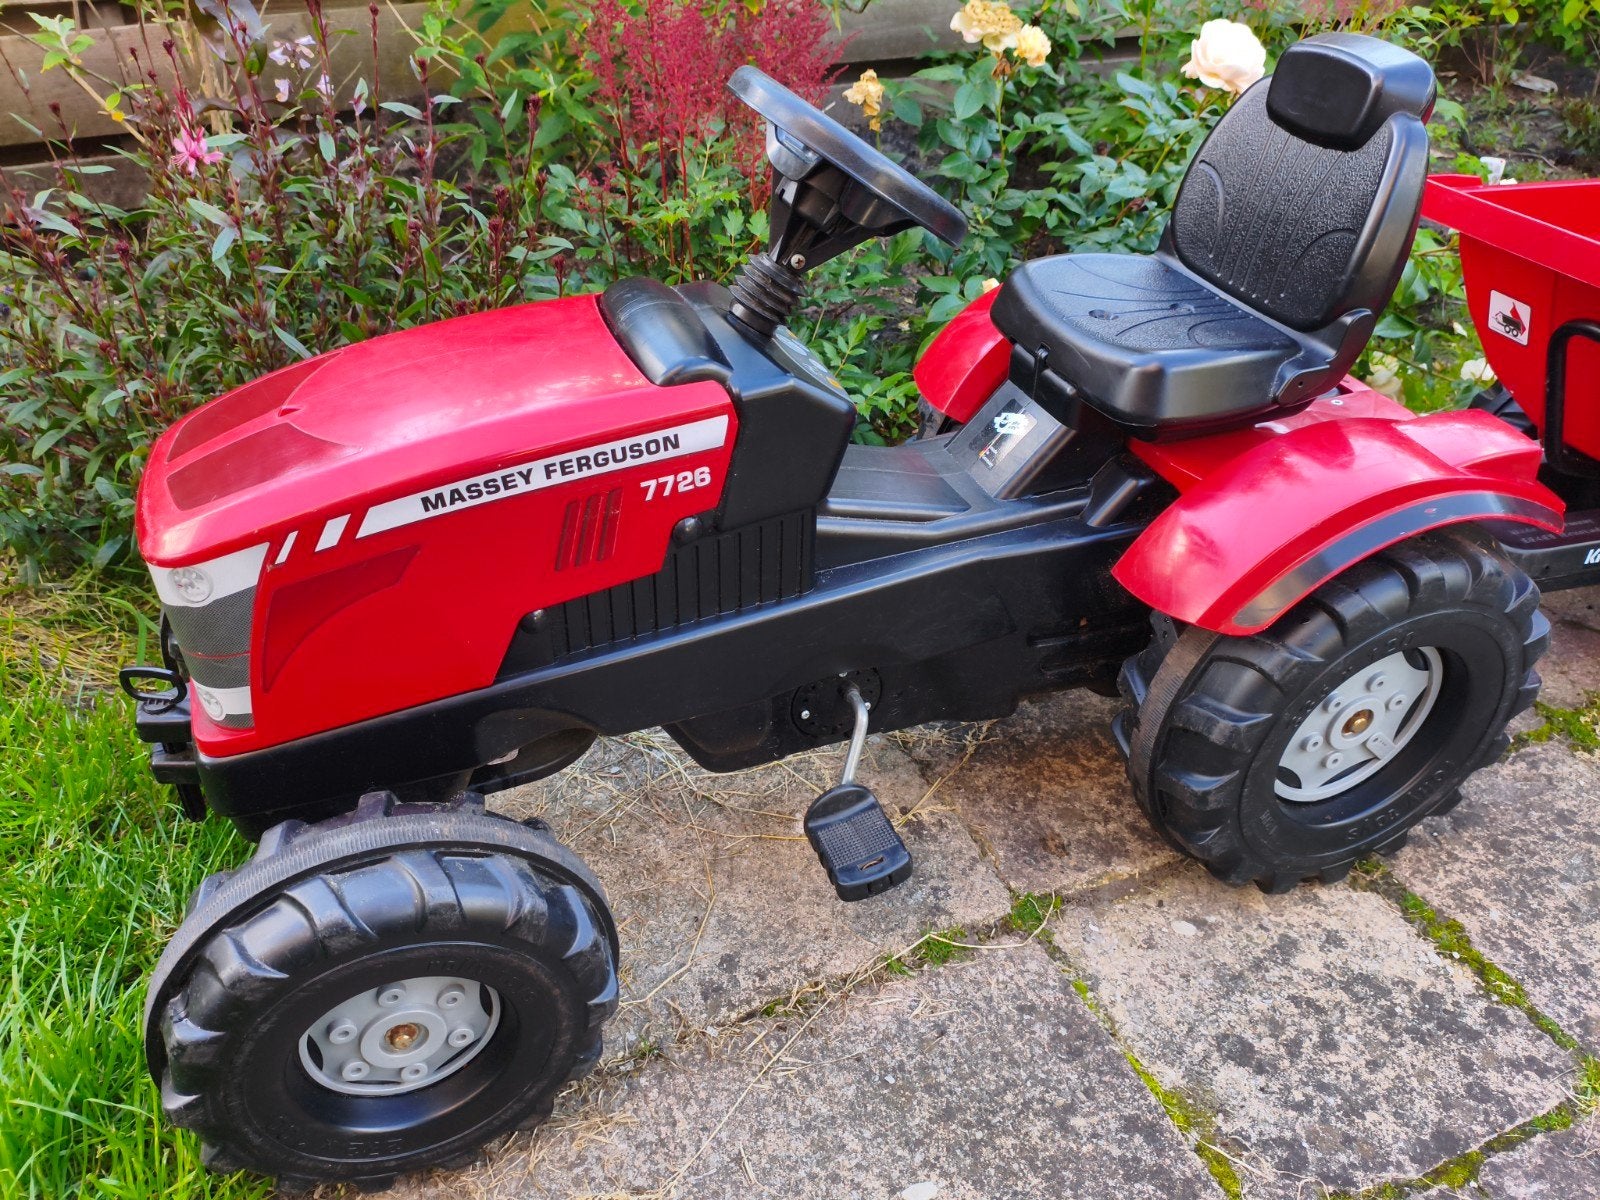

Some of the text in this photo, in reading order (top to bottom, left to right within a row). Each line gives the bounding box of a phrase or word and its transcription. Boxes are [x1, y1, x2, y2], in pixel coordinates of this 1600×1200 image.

[420, 433, 681, 512] MASSEY FERGUSON
[639, 466, 712, 502] 7726
